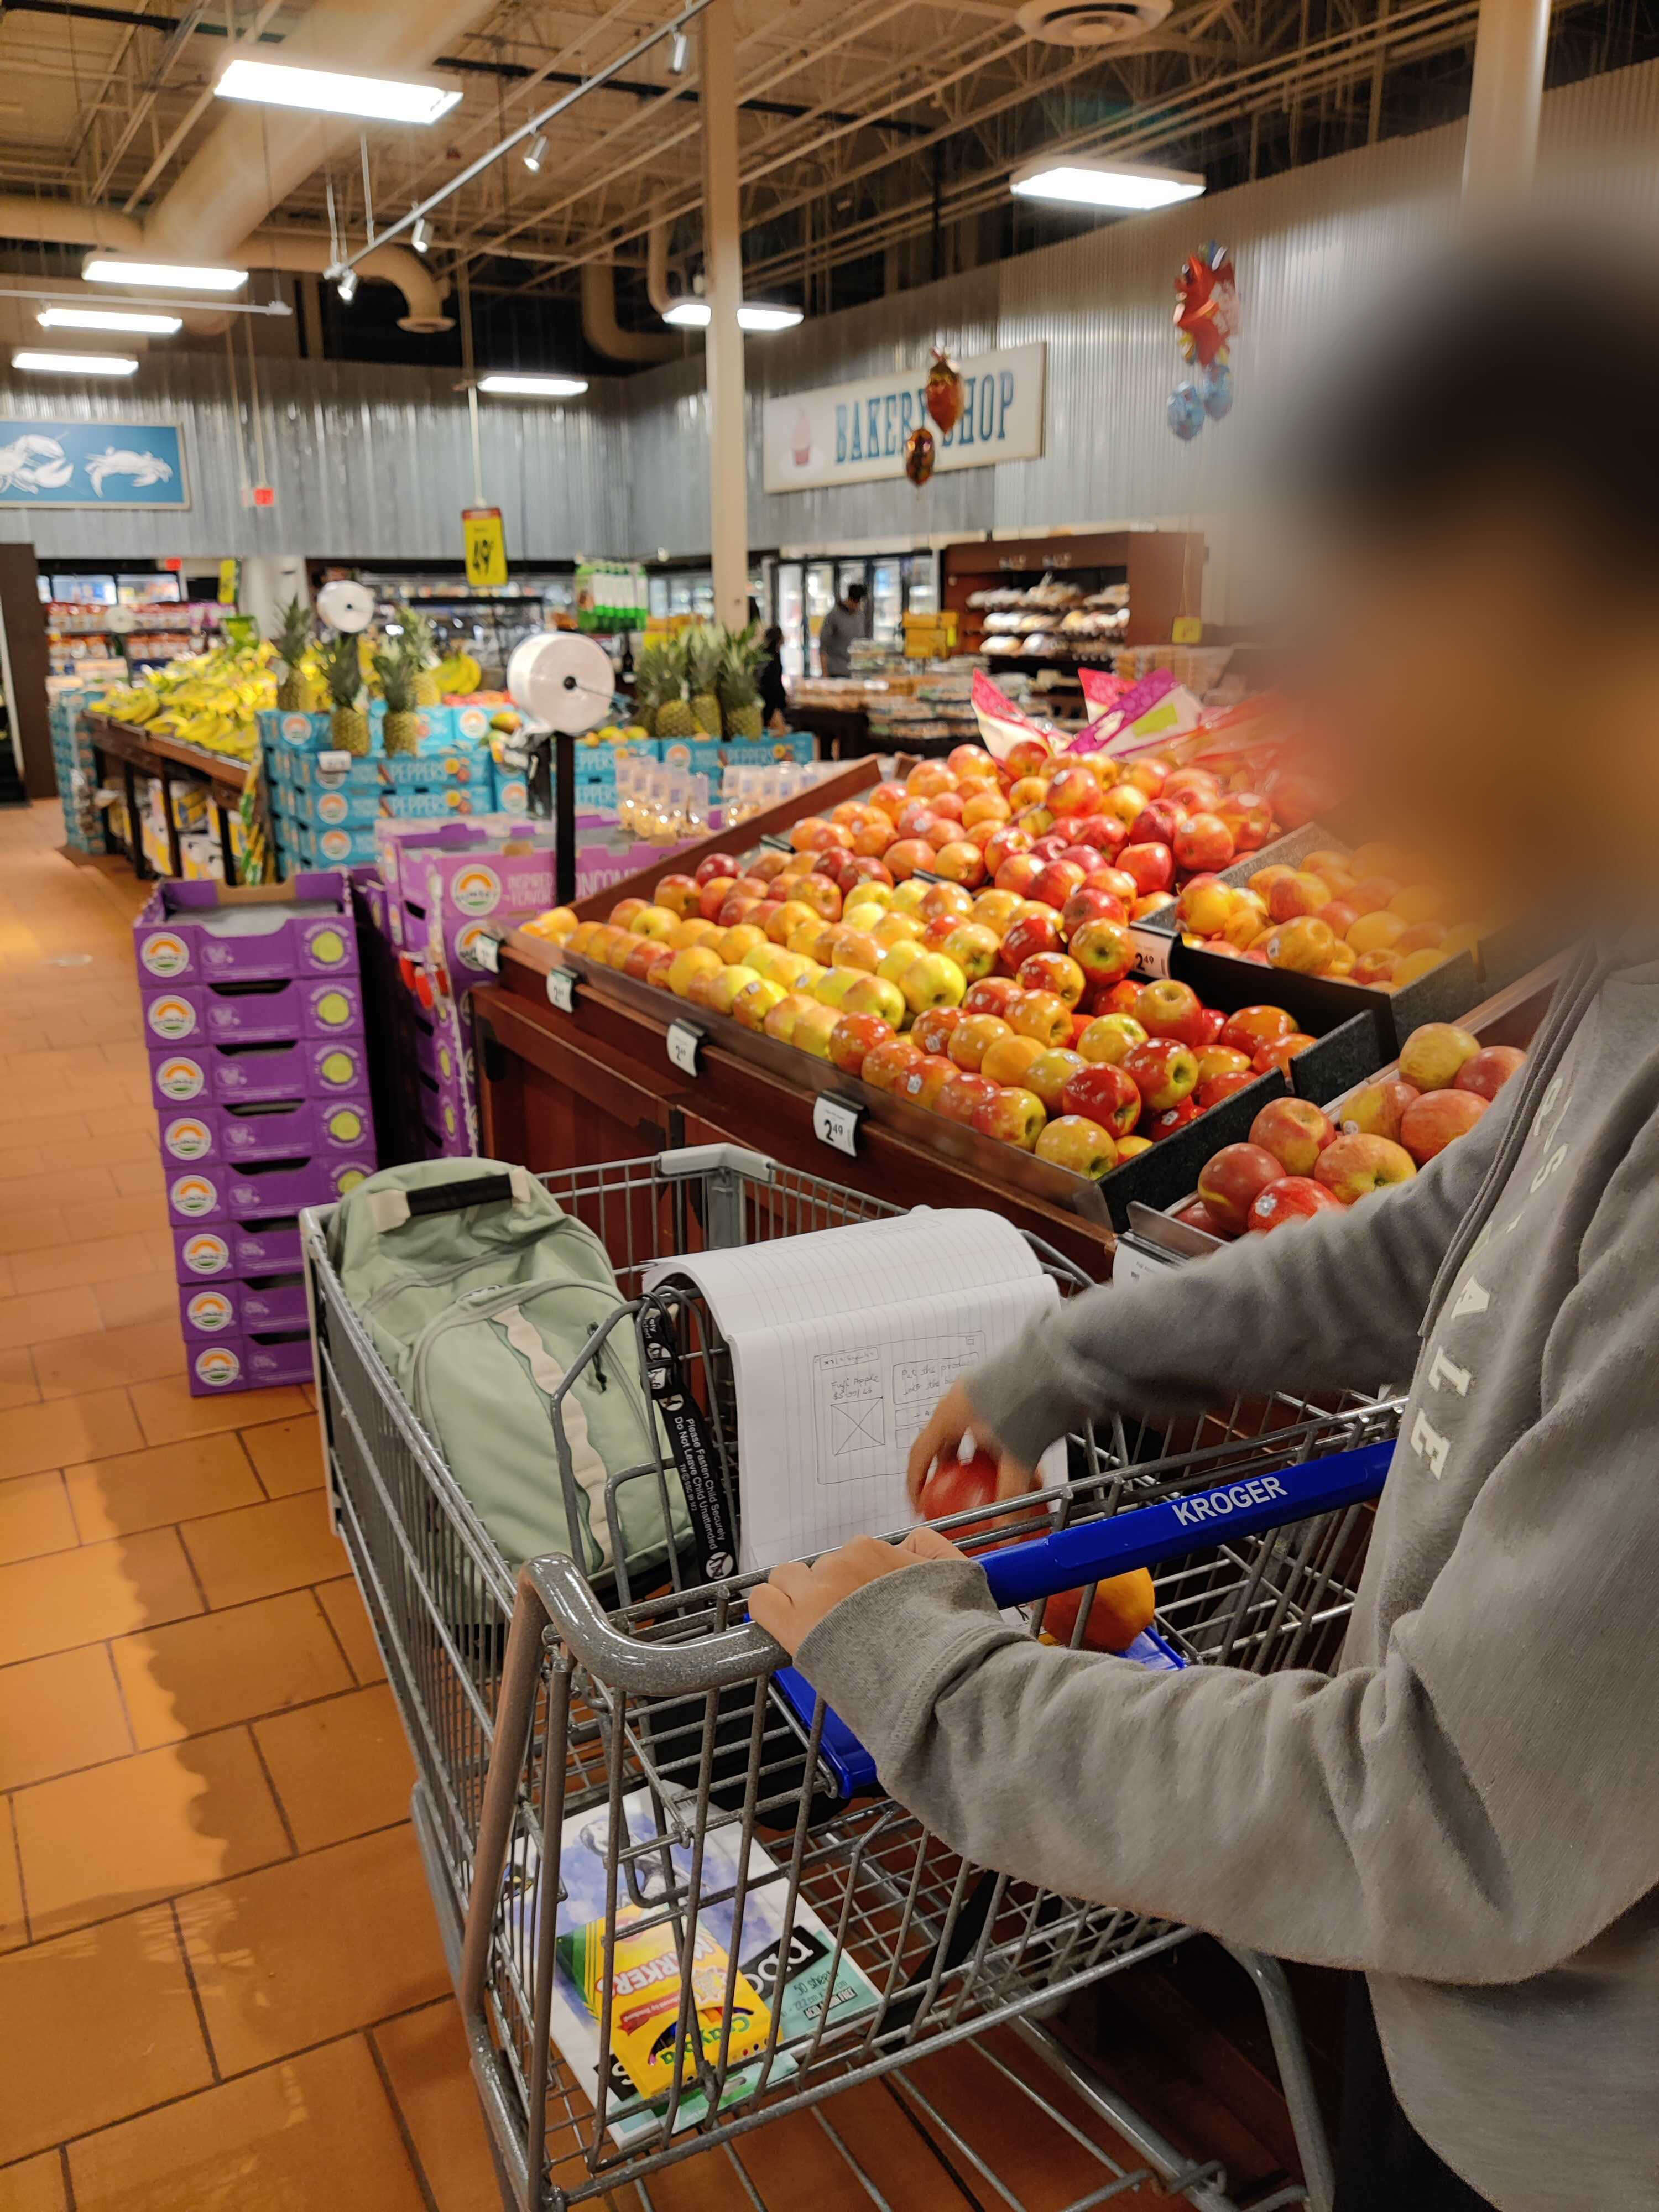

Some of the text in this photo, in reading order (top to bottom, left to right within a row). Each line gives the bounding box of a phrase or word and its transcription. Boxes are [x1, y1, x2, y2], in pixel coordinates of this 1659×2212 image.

[941, 371, 1014, 448] HOP
[674, 1416, 718, 1550] Do Not Leave Child Unattended
[686, 1418, 726, 1540] Please Fasten Child Securely
[1171, 1476, 1288, 1526] KROGER
